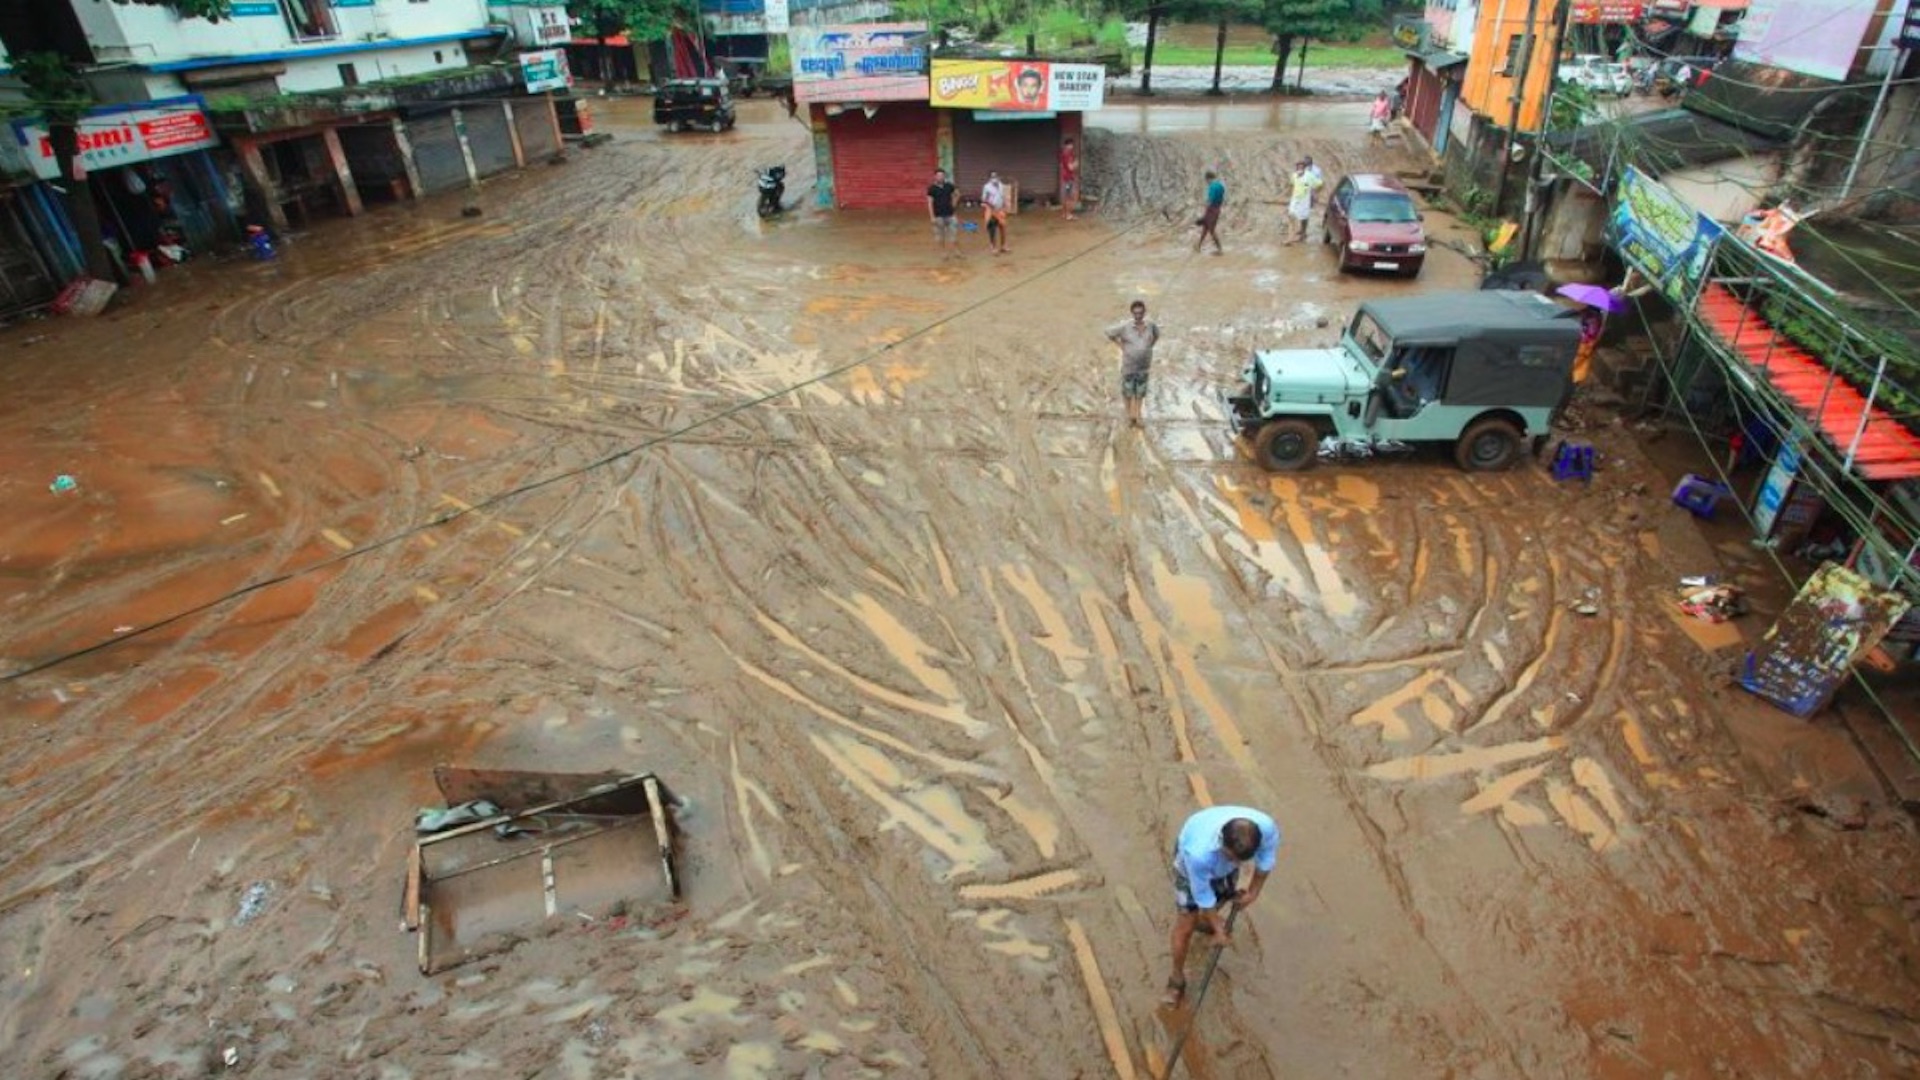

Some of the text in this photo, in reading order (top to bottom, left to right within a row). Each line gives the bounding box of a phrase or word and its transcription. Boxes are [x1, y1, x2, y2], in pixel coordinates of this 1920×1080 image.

[1054, 71, 1098, 82] NEW STAR
[1058, 82, 1092, 92] BAKERY
